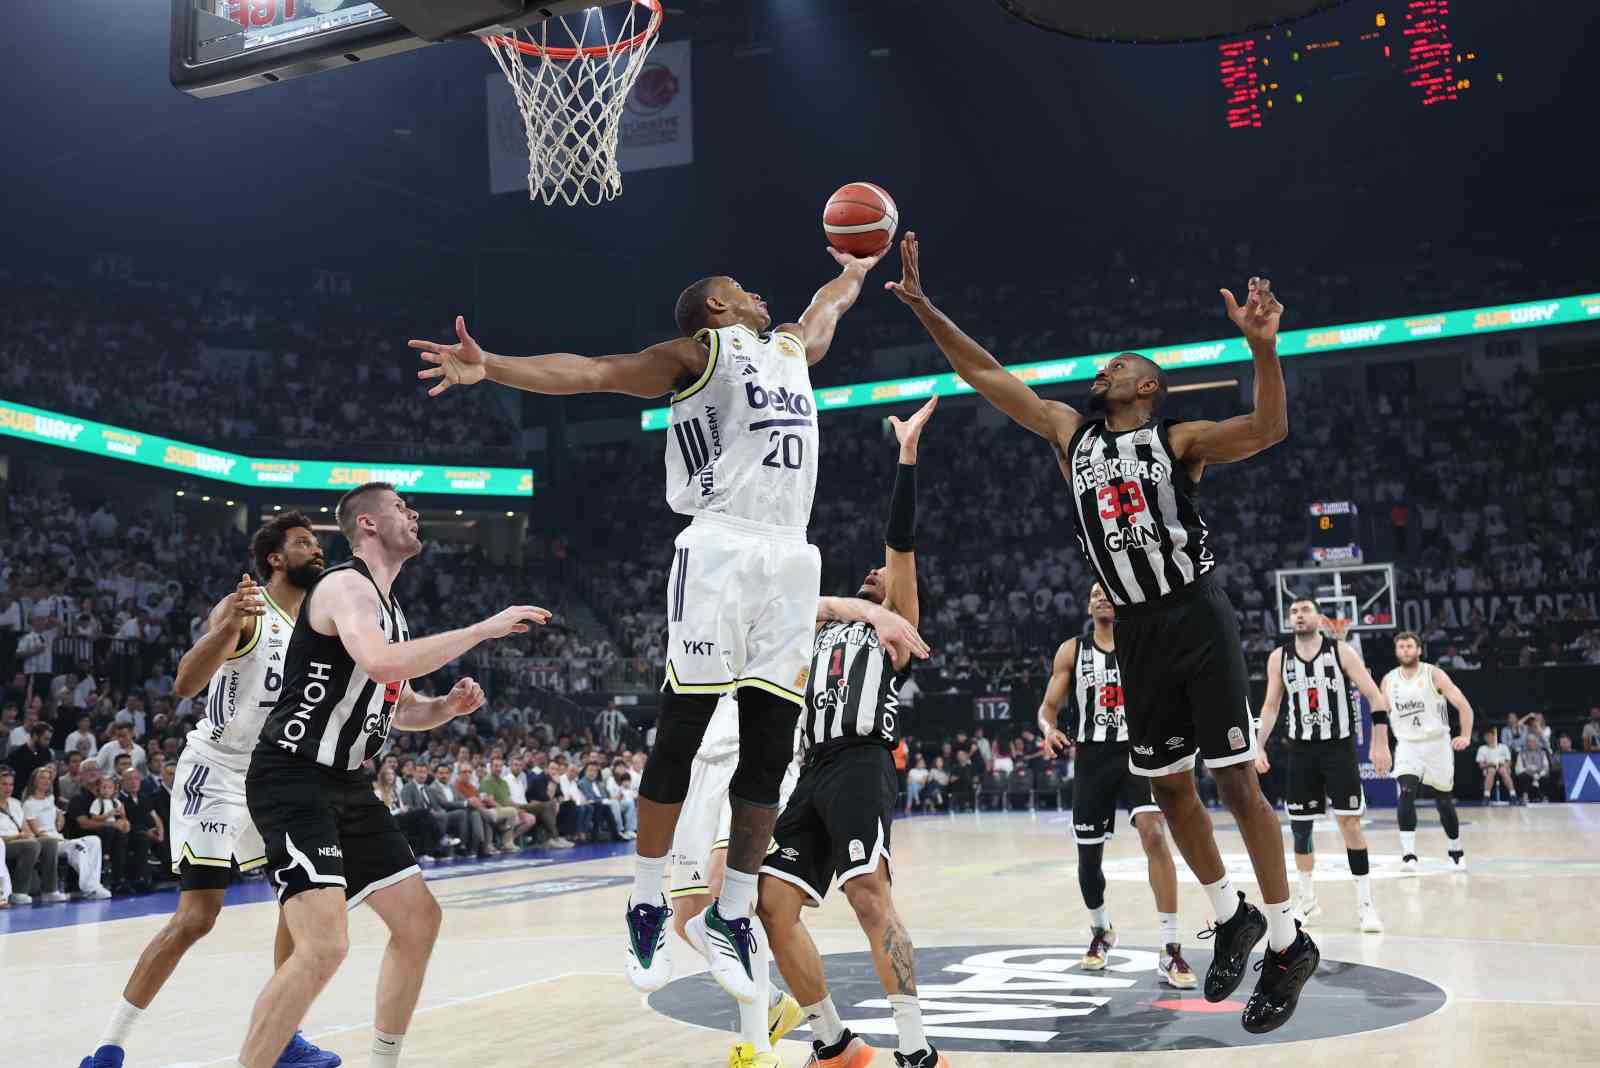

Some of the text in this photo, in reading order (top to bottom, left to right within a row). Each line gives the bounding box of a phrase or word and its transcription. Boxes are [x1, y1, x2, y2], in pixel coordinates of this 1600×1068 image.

[1473, 302, 1560, 329] SUBWAY
[1306, 324, 1386, 349] SUBWAY
[1009, 361, 1076, 381] UBWAY
[745, 381, 811, 416] beko
[871, 379, 937, 400] SUBWAY
[164, 446, 237, 475] SUBWAY
[762, 430, 803, 469] 20
[328, 466, 424, 487] SUBWAY
[1098, 481, 1146, 521] 33
[683, 640, 715, 656] YKT
[829, 648, 843, 676] 1
[976, 702, 1010, 720] 112
[200, 821, 228, 835] YKT
